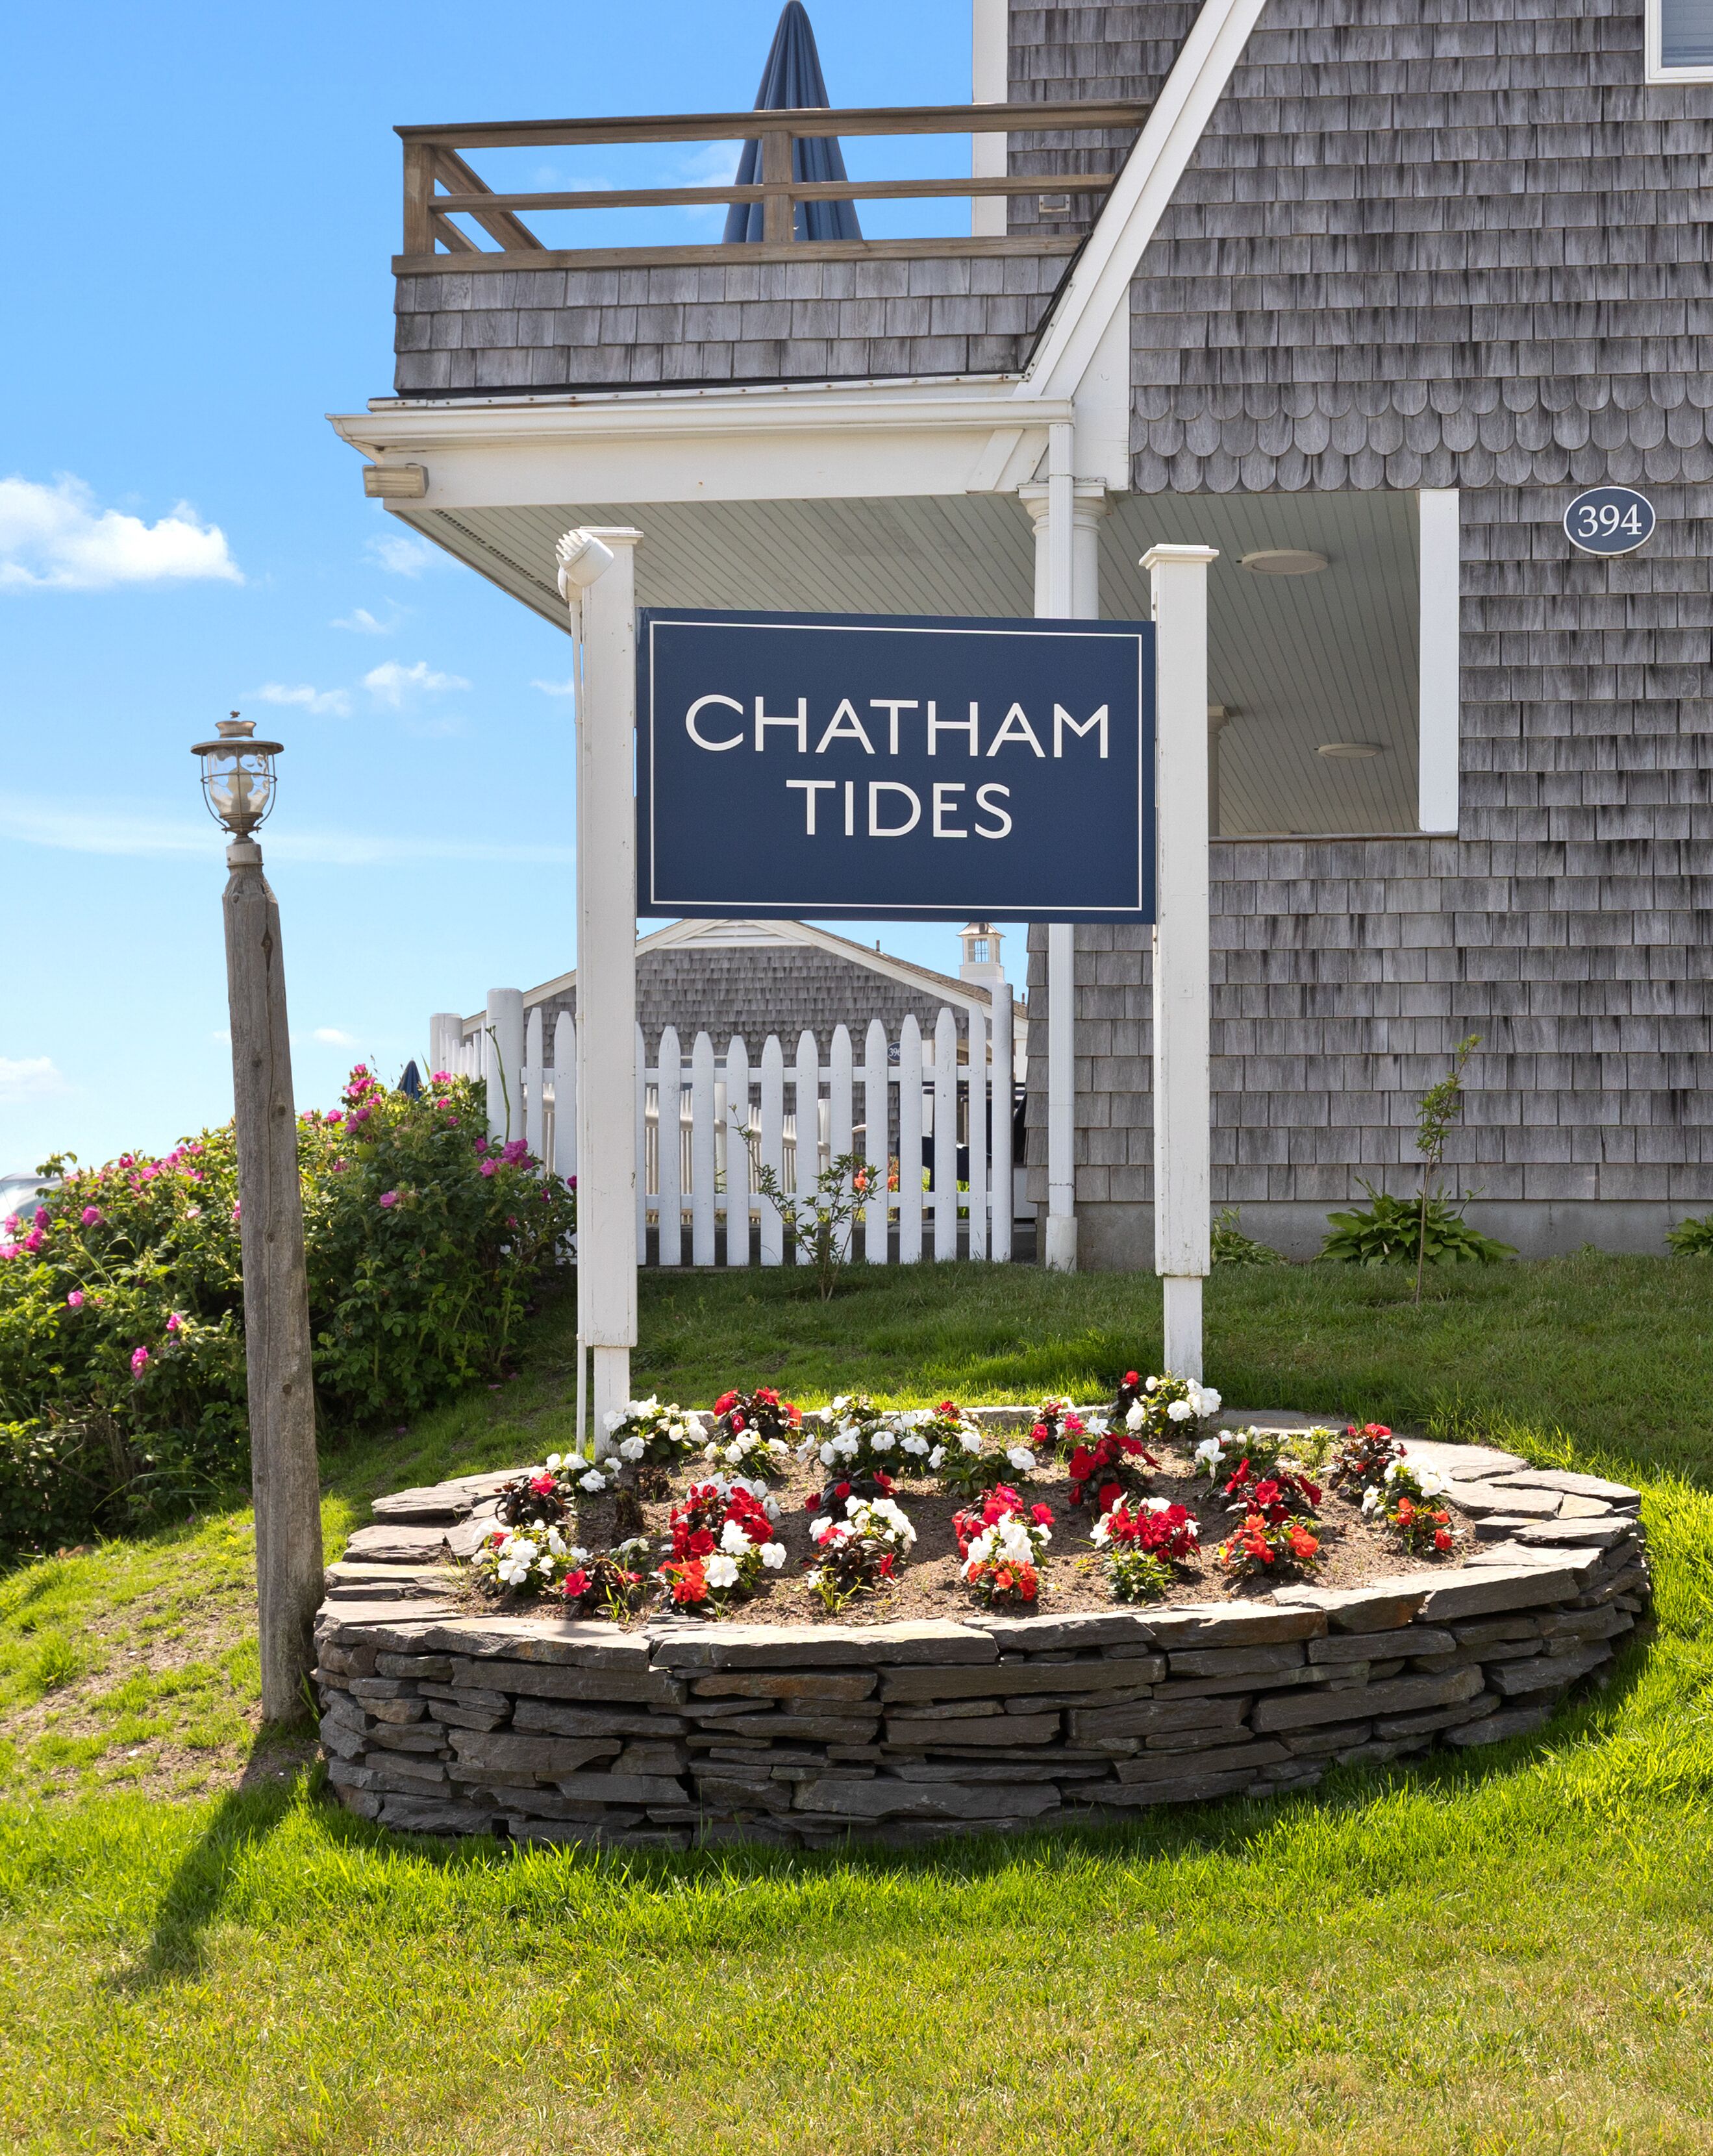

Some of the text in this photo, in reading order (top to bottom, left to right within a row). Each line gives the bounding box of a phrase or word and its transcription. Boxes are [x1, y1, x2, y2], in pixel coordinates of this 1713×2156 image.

[1578, 504, 1642, 537] 394
[686, 695, 1108, 758] CHATHAM
[786, 780, 1012, 839] TIDES
